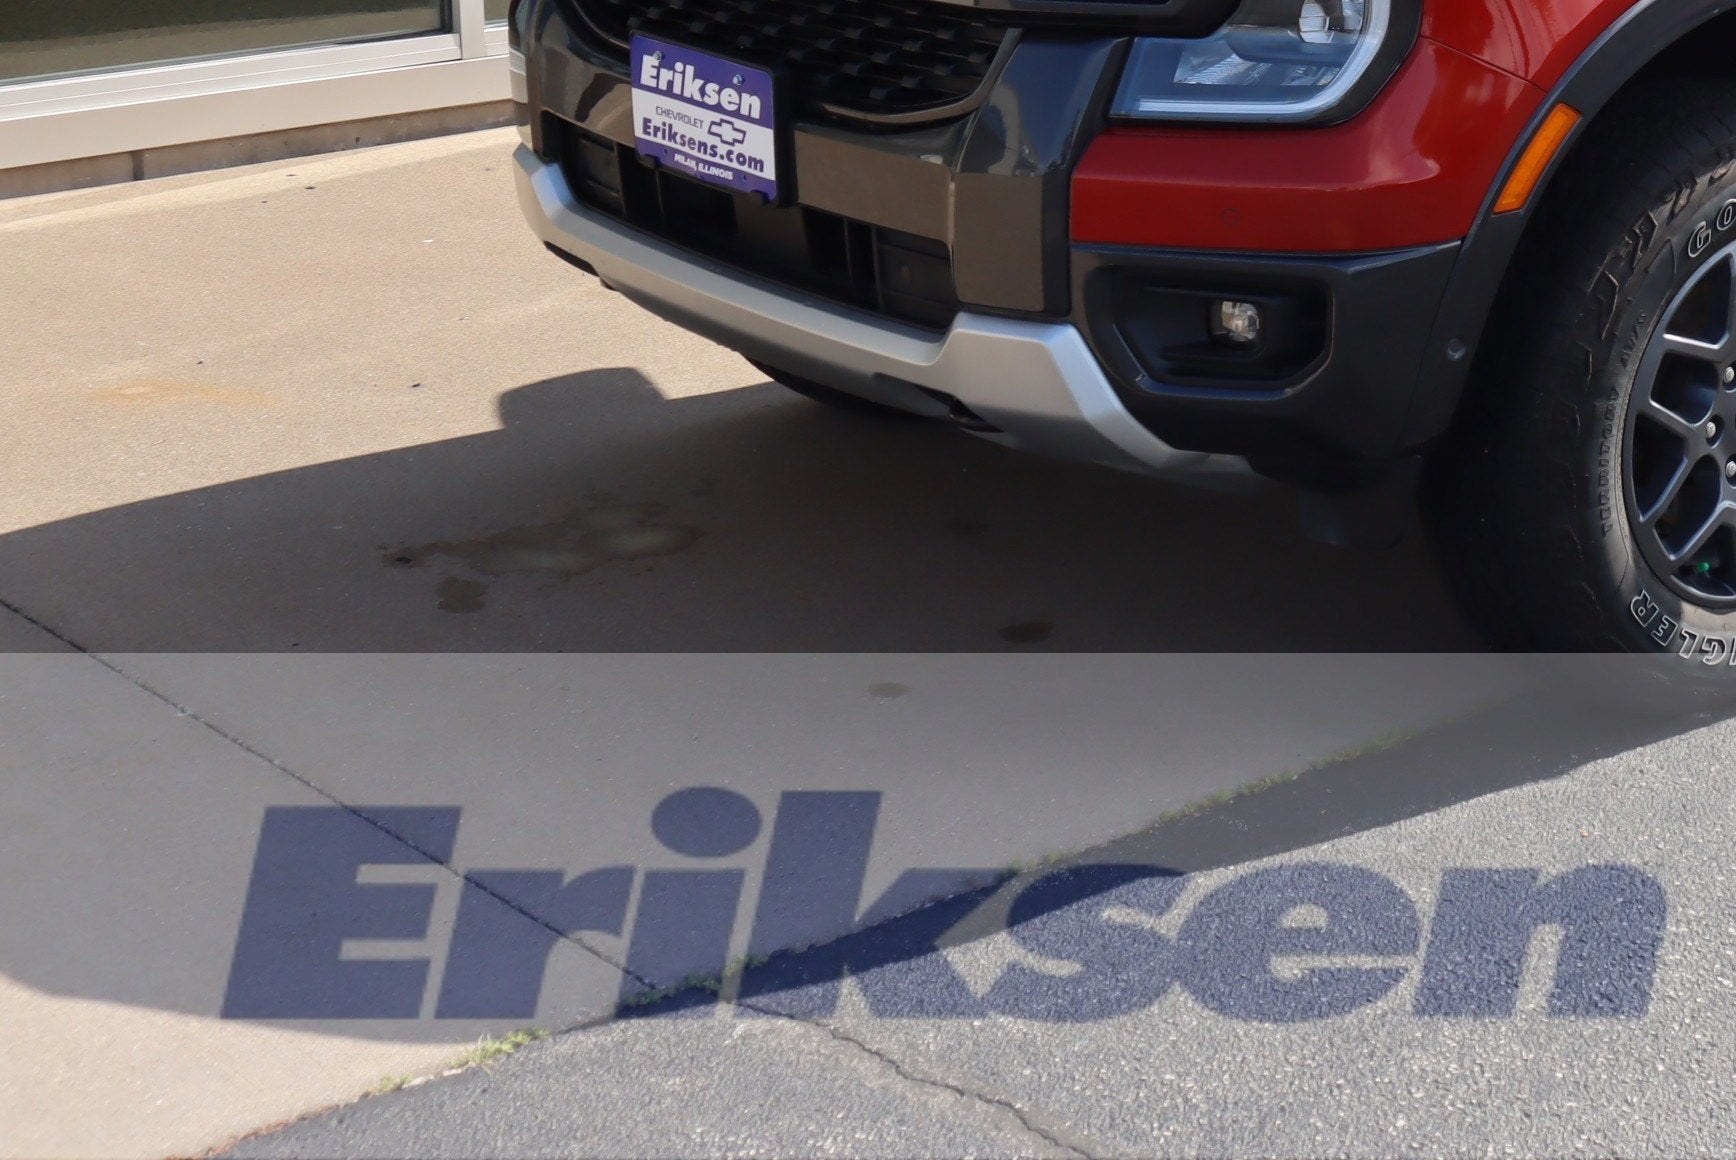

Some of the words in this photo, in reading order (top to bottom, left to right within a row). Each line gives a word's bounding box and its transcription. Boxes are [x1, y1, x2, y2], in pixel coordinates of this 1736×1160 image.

[639, 54, 762, 120] Eriksen
[655, 105, 704, 130] CHEVROLET
[642, 117, 765, 173] Eriksens.com
[698, 161, 734, 181] ILLINOIS
